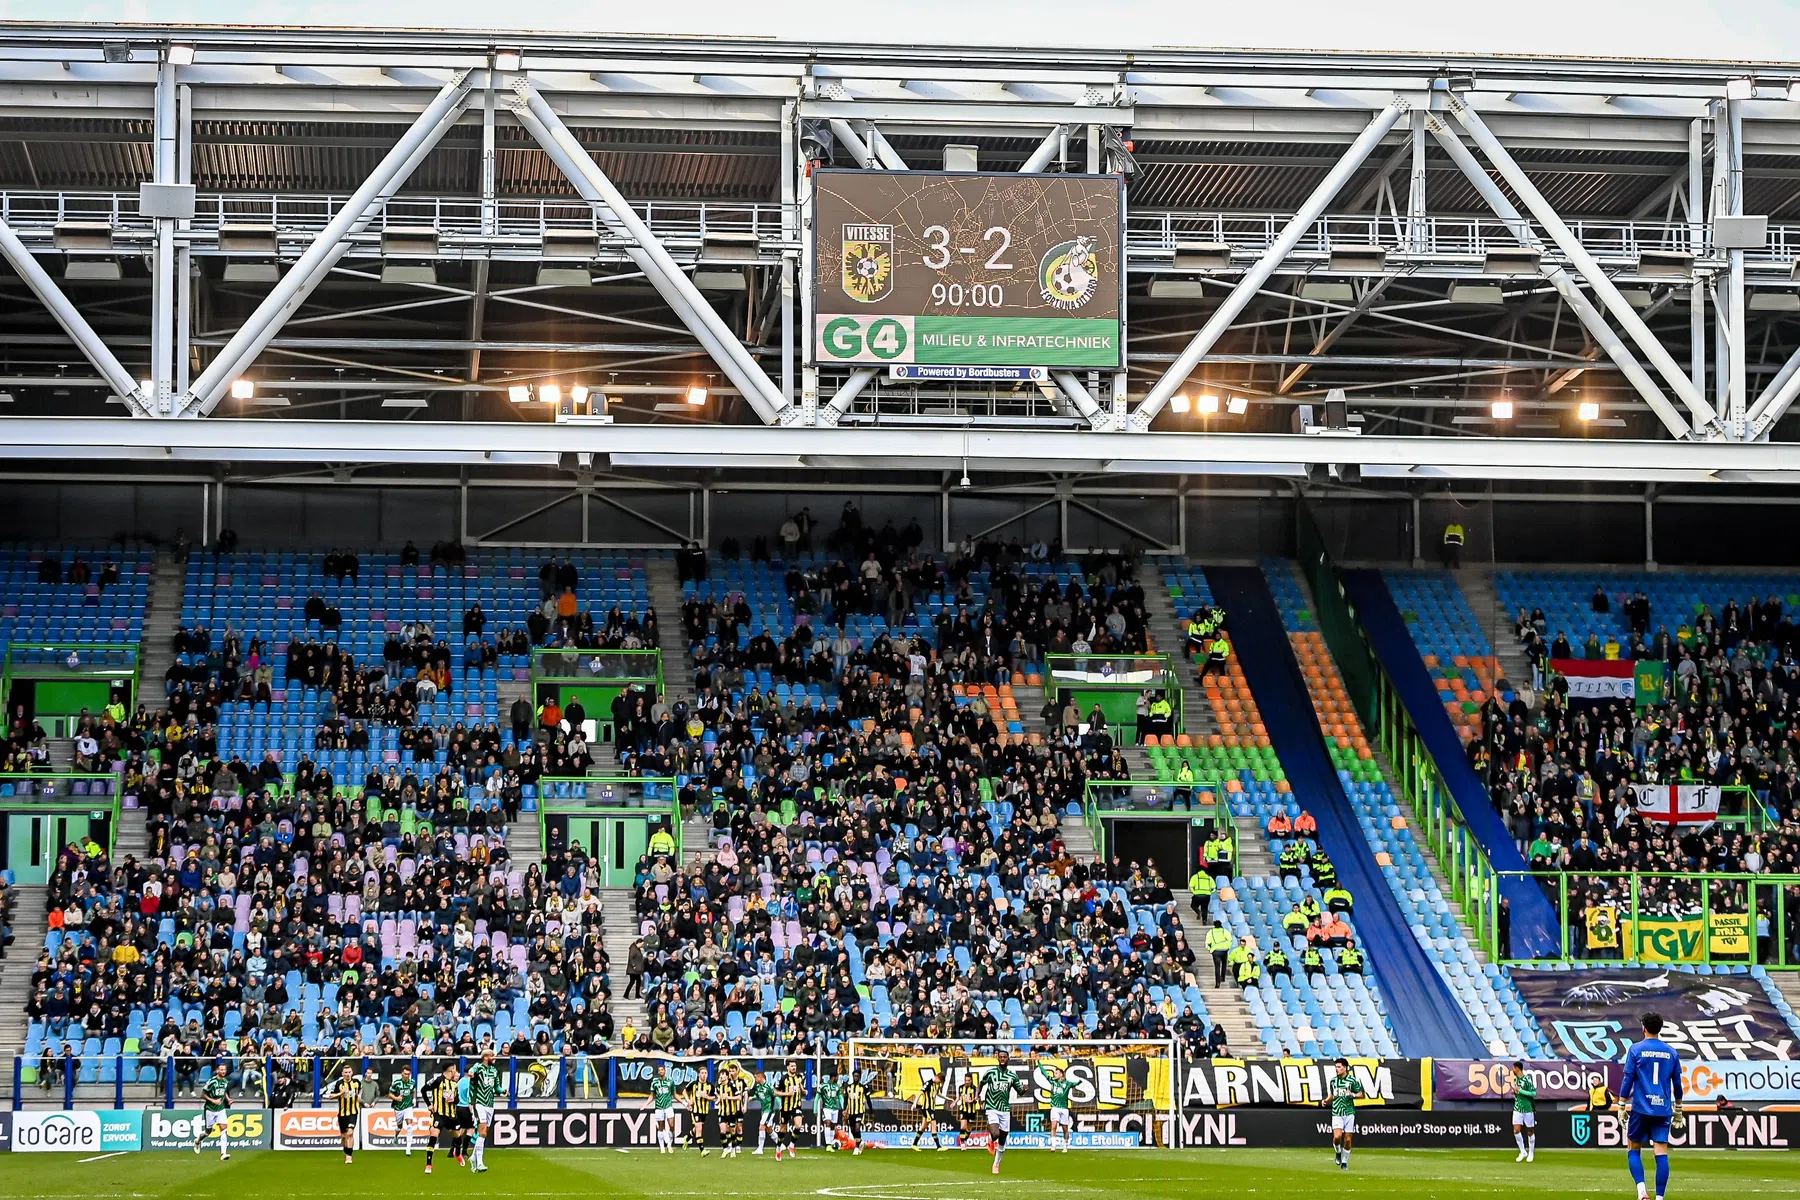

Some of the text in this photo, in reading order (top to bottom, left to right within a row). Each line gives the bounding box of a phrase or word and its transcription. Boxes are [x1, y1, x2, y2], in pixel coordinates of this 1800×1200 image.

[847, 226, 889, 241] VITESSE
[931, 284, 1003, 307] 90:00
[822, 317, 908, 359] G4
[922, 334, 1112, 349] MILIEU & INFRATECHNIEK
[917, 367, 1020, 380] Powered by Bordbusters
[1714, 918, 1742, 926] PASSIE
[1631, 928, 1701, 960] TGV
[1720, 937, 1738, 945] TGV
[1654, 1015, 1754, 1042] BET
[619, 1062, 653, 1081] We
[1653, 1062, 1660, 1085] 1
[103, 1123, 131, 1131] ZORGT
[1362, 1123, 1399, 1135] gokken
[1400, 1123, 1421, 1135] jou?
[1423, 1124, 1446, 1135] Stop
[1449, 1126, 1461, 1136] op
[1463, 1124, 1482, 1135] tijd.
[1484, 1124, 1502, 1134] 18+
[103, 1134, 139, 1142] ERVOOR.
[1006, 1134, 1045, 1147] korting
[1076, 1135, 1090, 1145] de
[1093, 1134, 1134, 1147] Efteling!
